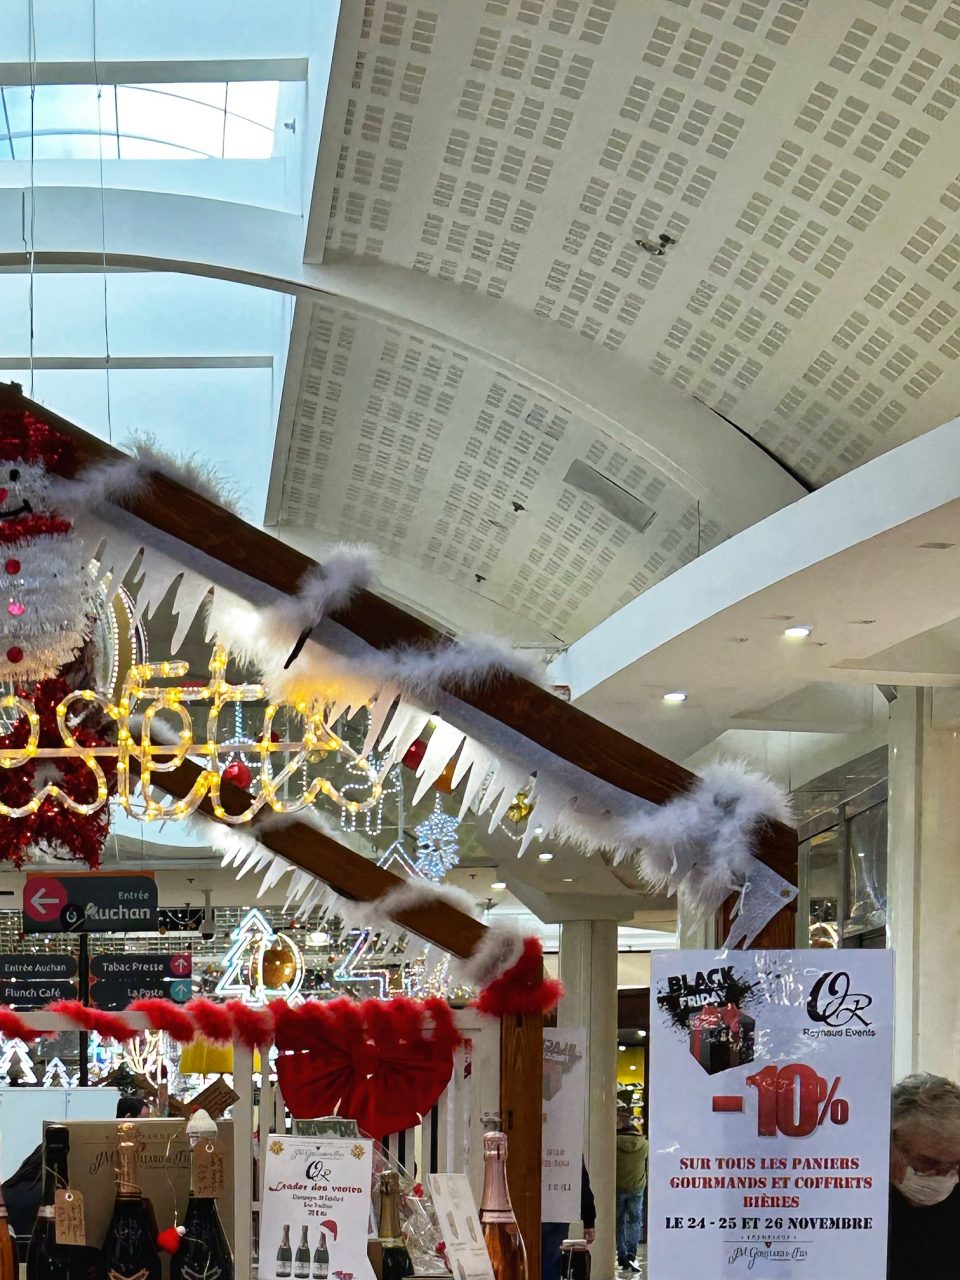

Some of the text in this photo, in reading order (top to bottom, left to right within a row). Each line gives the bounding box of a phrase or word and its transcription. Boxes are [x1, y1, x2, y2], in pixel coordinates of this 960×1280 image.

[118, 891, 150, 900] Entrée
[84, 903, 151, 920] Auchan
[4, 962, 67, 972] Entrée Auchan
[102, 962, 164, 972] Tabac Presse
[667, 966, 736, 995] BLACK
[5, 988, 61, 998] Flunch Café
[127, 988, 164, 999] La Poste
[679, 1157, 860, 1170] SUR TOUS LES PANIERS
[670, 1176, 873, 1189] GOURMANDS ET COFFRETS
[743, 1192, 800, 1208] BIÈRES
[665, 1217, 683, 1230] LE
[687, 1217, 706, 1230] 24
[718, 1217, 737, 1230] 25
[741, 1217, 761, 1230] ET
[765, 1217, 783, 1230] 26
[787, 1217, 873, 1230] NOVEMBRE
